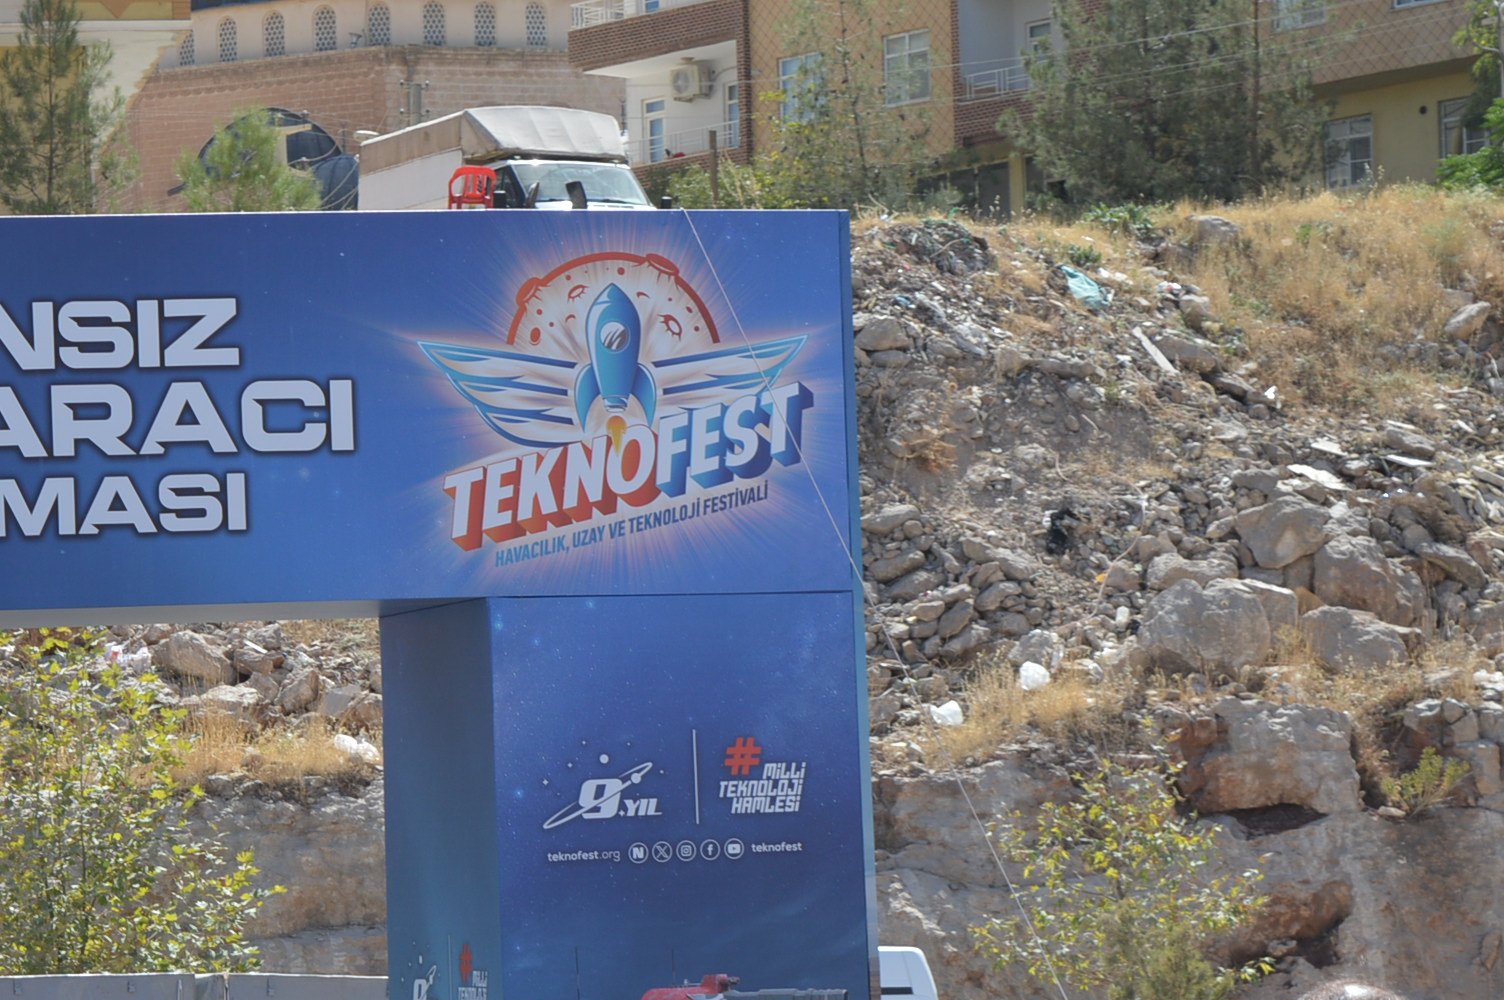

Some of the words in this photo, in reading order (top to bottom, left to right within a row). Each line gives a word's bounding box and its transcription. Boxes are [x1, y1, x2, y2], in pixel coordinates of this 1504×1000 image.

[443, 381, 815, 552] TEKNOFEST
[572, 524, 606, 549] UZAY
[608, 520, 626, 540] VE
[628, 499, 700, 535] TEKNOLOJİ
[703, 480, 768, 516] FESTİVALİ
[547, 850, 621, 863] teknofest.org
[751, 842, 802, 853] teknofest
